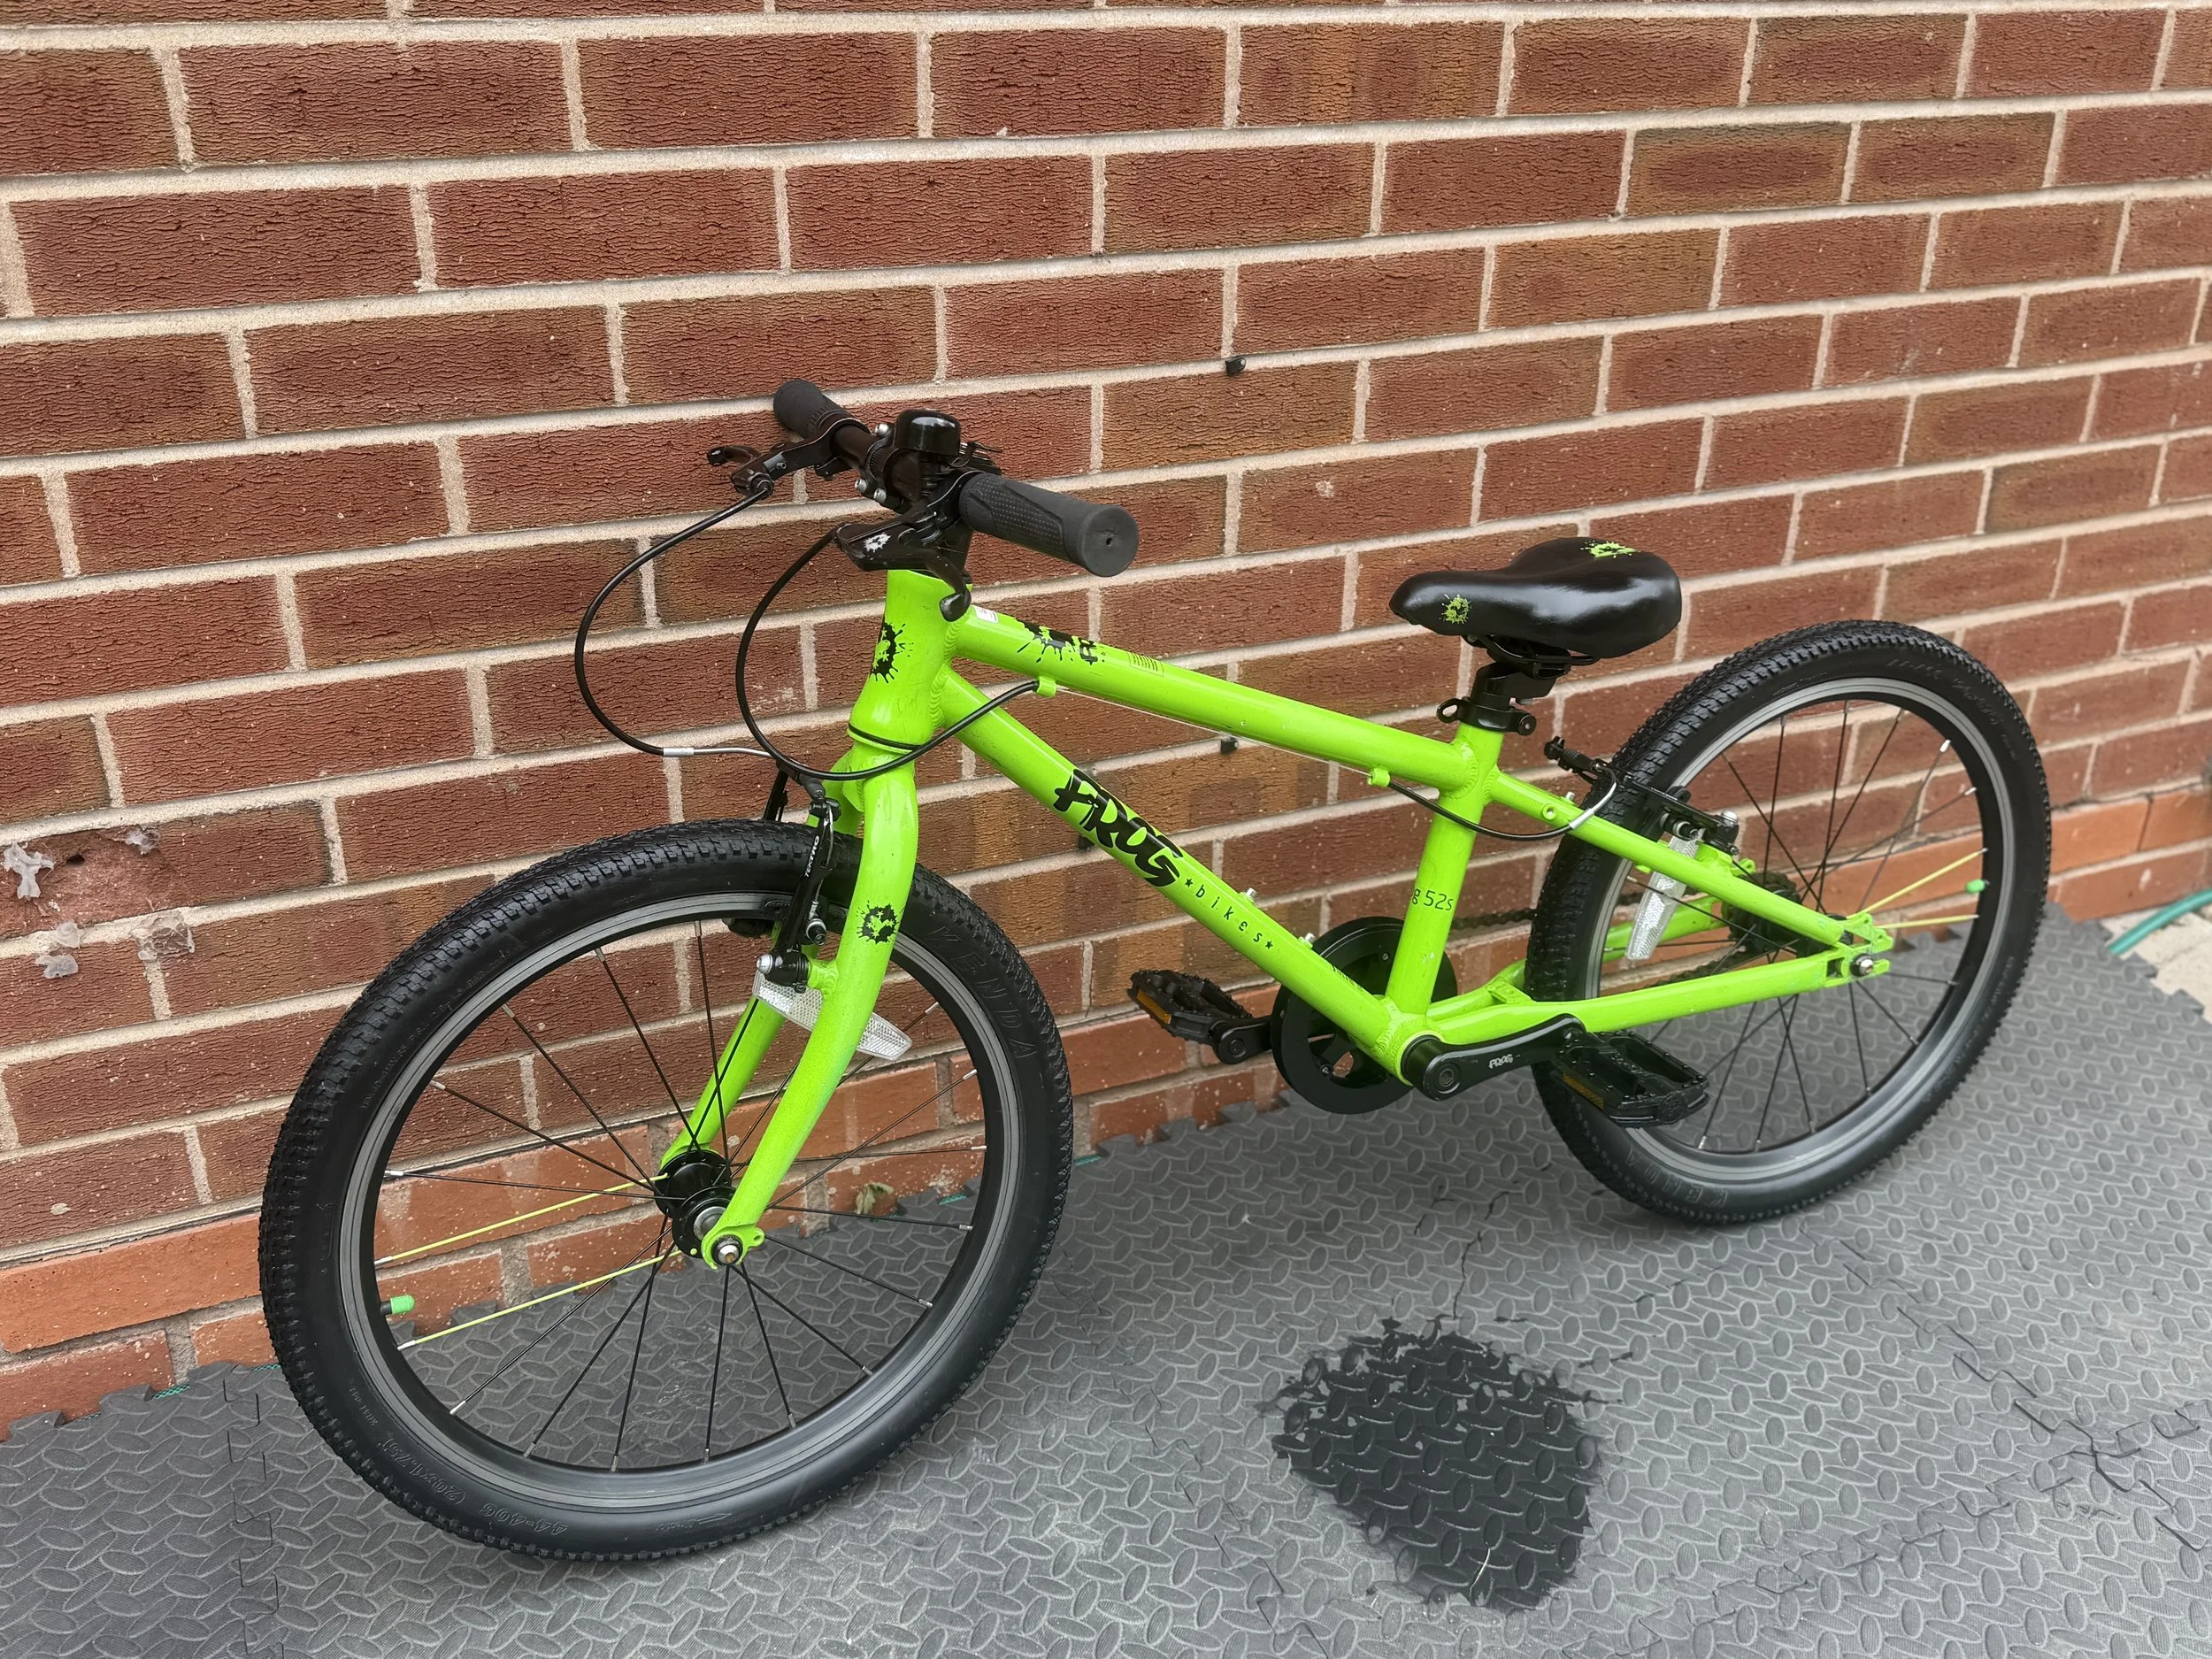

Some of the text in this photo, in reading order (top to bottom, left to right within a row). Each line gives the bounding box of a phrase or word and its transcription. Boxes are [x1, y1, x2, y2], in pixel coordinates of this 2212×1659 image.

[803, 835, 820, 878] TEKTRO
[1053, 769, 1263, 943] FROG bikes
[1424, 890, 1454, 911] 52s
[1488, 1054, 1514, 1069] FROG
[480, 1502, 568, 1537] 44-406
